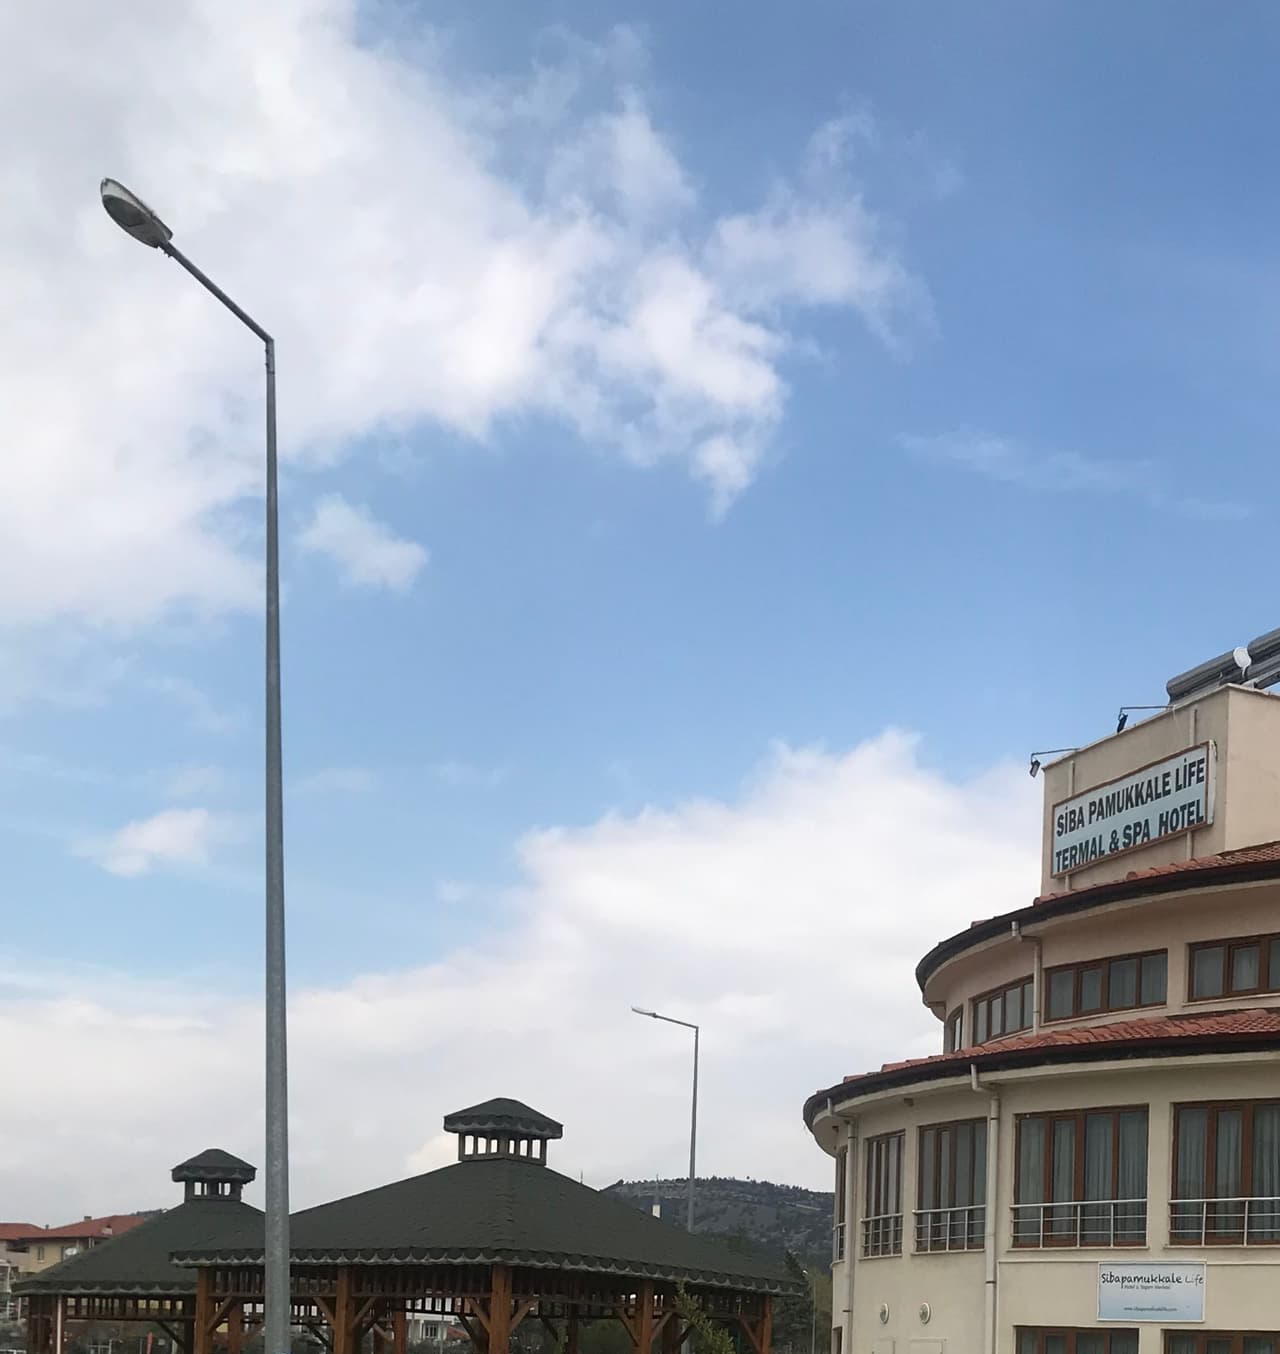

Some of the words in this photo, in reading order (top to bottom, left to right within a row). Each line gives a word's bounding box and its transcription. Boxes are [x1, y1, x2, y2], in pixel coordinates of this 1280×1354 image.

[1056, 804, 1085, 837] SİBA
[1089, 771, 1171, 825] PAMUKKALE
[1175, 757, 1205, 792] LİFE
[1055, 834, 1105, 873] TERMAL
[1109, 829, 1120, 853] &
[1122, 818, 1150, 848] SPA
[1158, 799, 1204, 837] HOTEL
